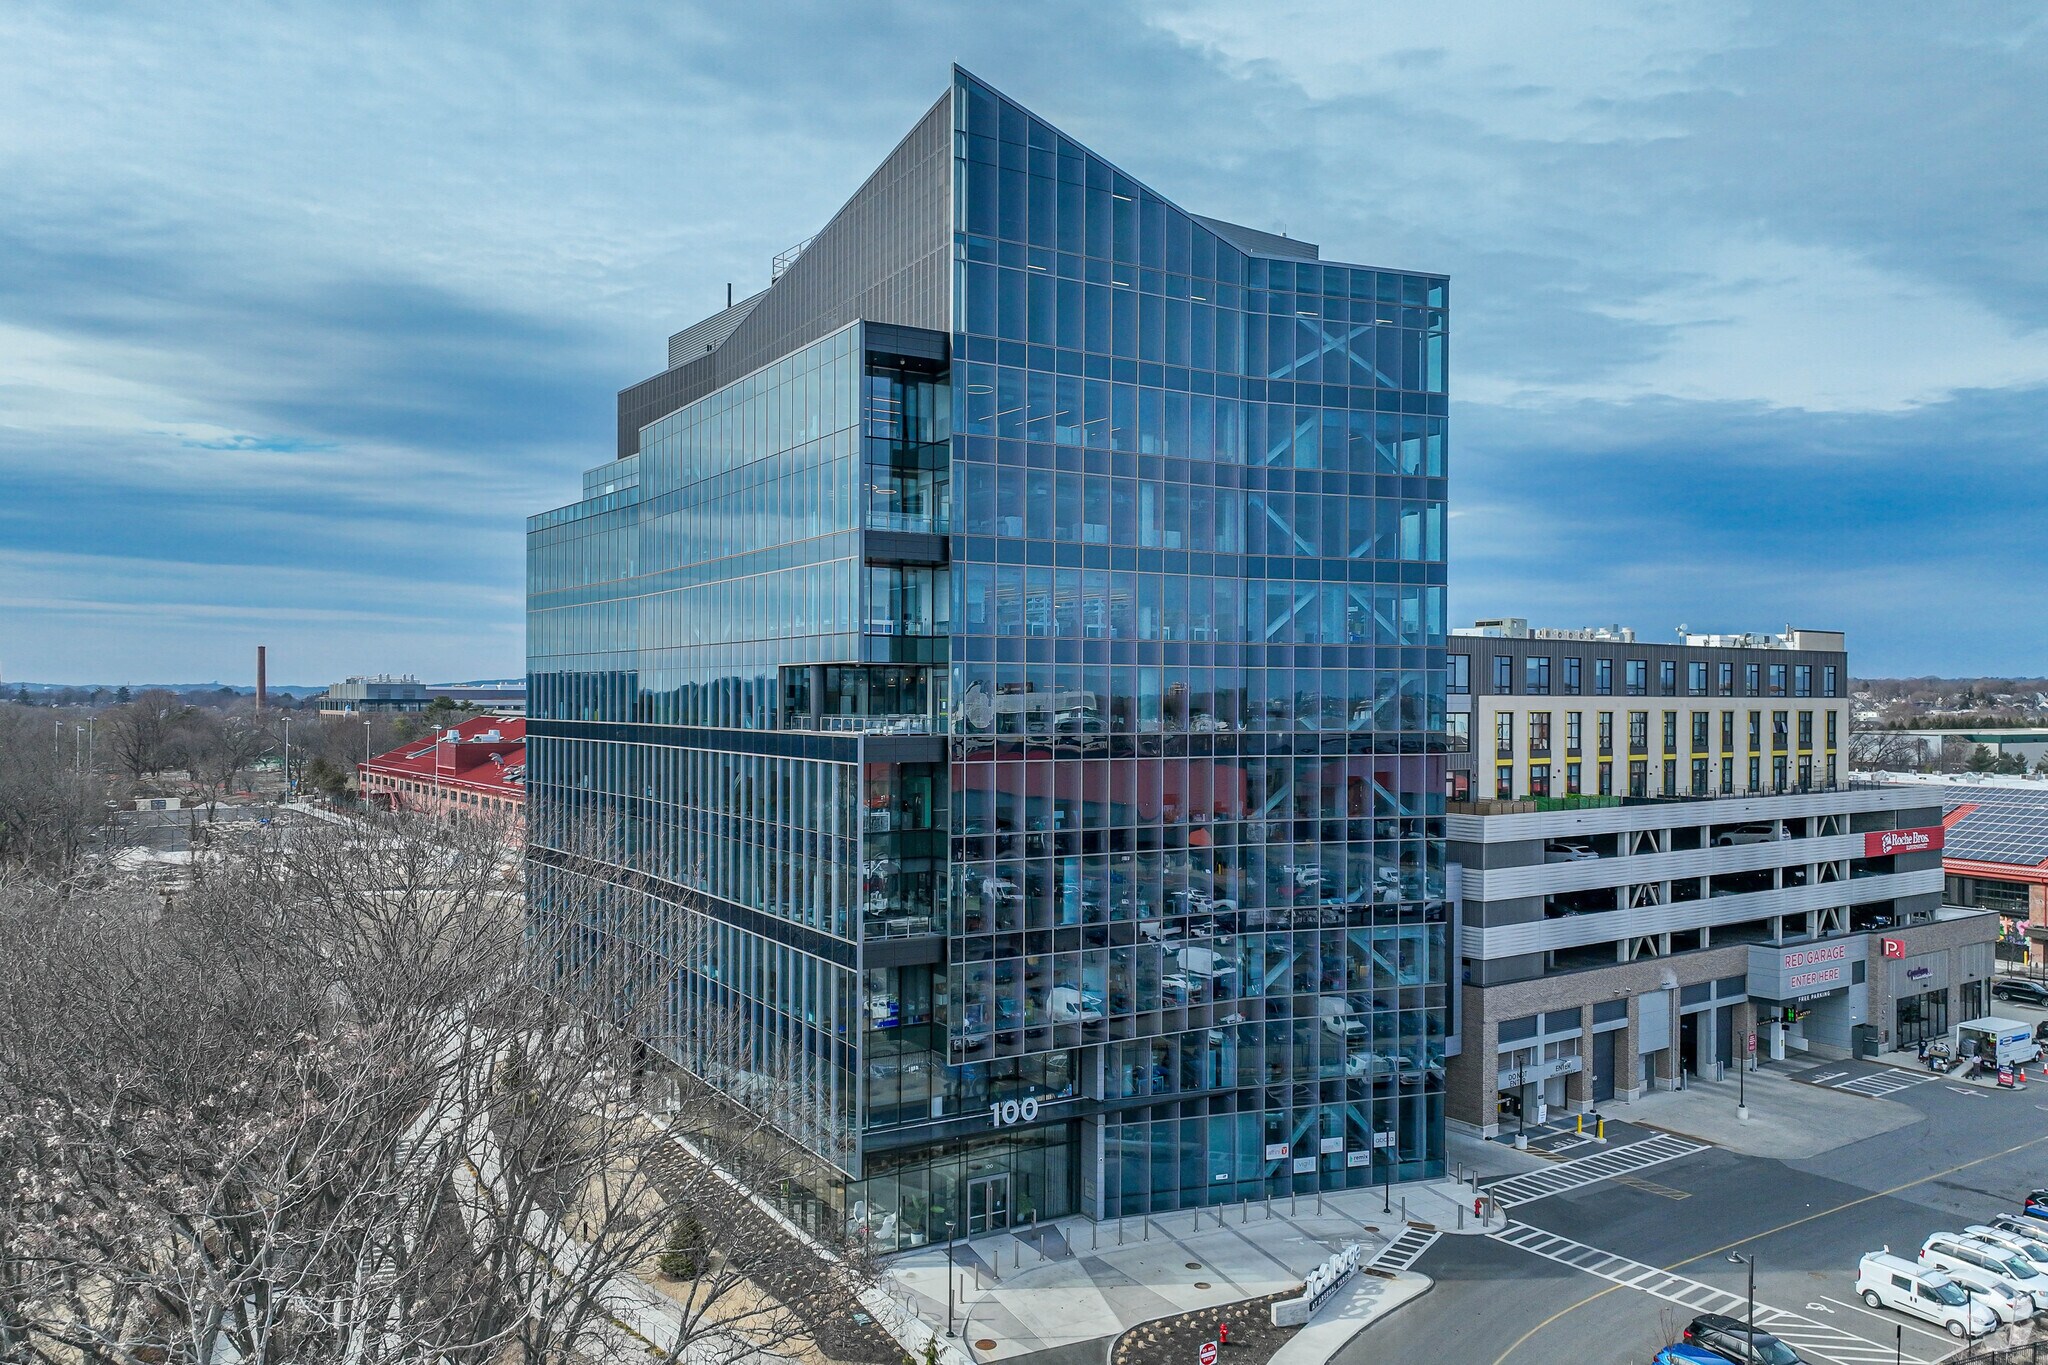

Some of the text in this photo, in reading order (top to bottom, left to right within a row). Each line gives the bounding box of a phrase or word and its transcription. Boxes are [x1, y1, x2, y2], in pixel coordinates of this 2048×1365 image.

[1892, 833, 1913, 846] Roche
[1885, 940, 1898, 955] P
[1785, 945, 1846, 969] RED GARAGE
[1791, 968, 1840, 988] ENTER HERE
[1798, 991, 1831, 1003] FREE PARKING
[1509, 1073, 1516, 1081] DO
[1509, 1077, 1526, 1088] ENTR
[990, 1097, 1039, 1128] 100
[1353, 1153, 1369, 1161] remix
[1318, 1284, 1337, 1305] ARSENAL
